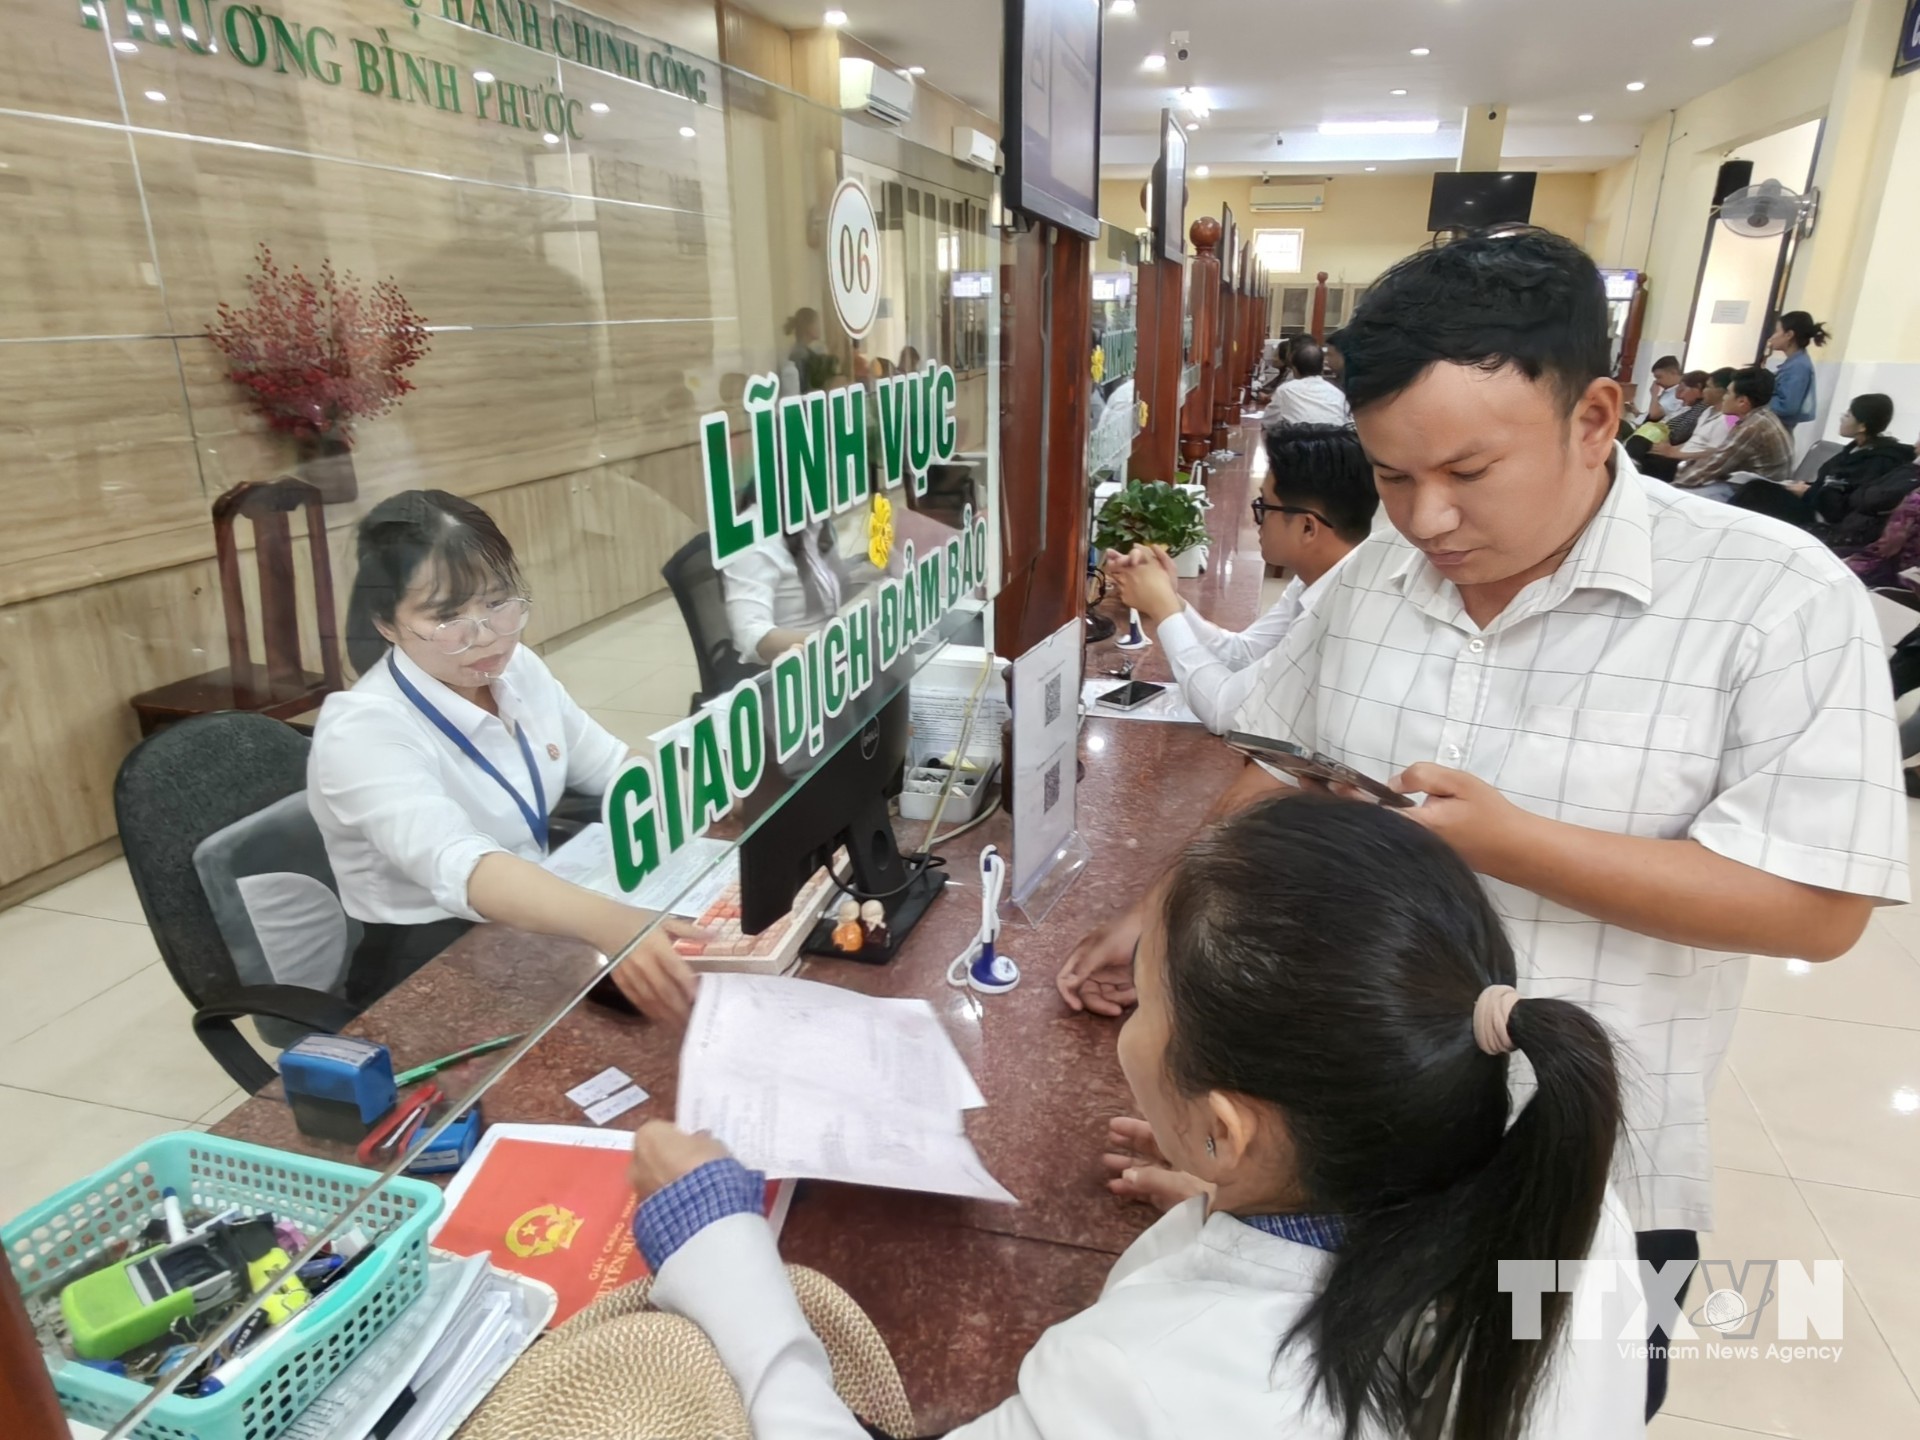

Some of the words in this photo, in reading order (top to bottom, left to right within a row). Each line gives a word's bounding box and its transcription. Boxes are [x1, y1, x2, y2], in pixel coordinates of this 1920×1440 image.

[351, 26, 463, 113] BÌNH
[473, 75, 584, 140] PHƯỚC
[839, 222, 872, 297] 06
[703, 375, 868, 564] LĨNH
[876, 363, 956, 493] VỰC
[606, 685, 765, 895] GIAO
[774, 602, 870, 751] DỊCH
[879, 542, 942, 667] ĐẢM
[946, 506, 987, 611] BẢO
